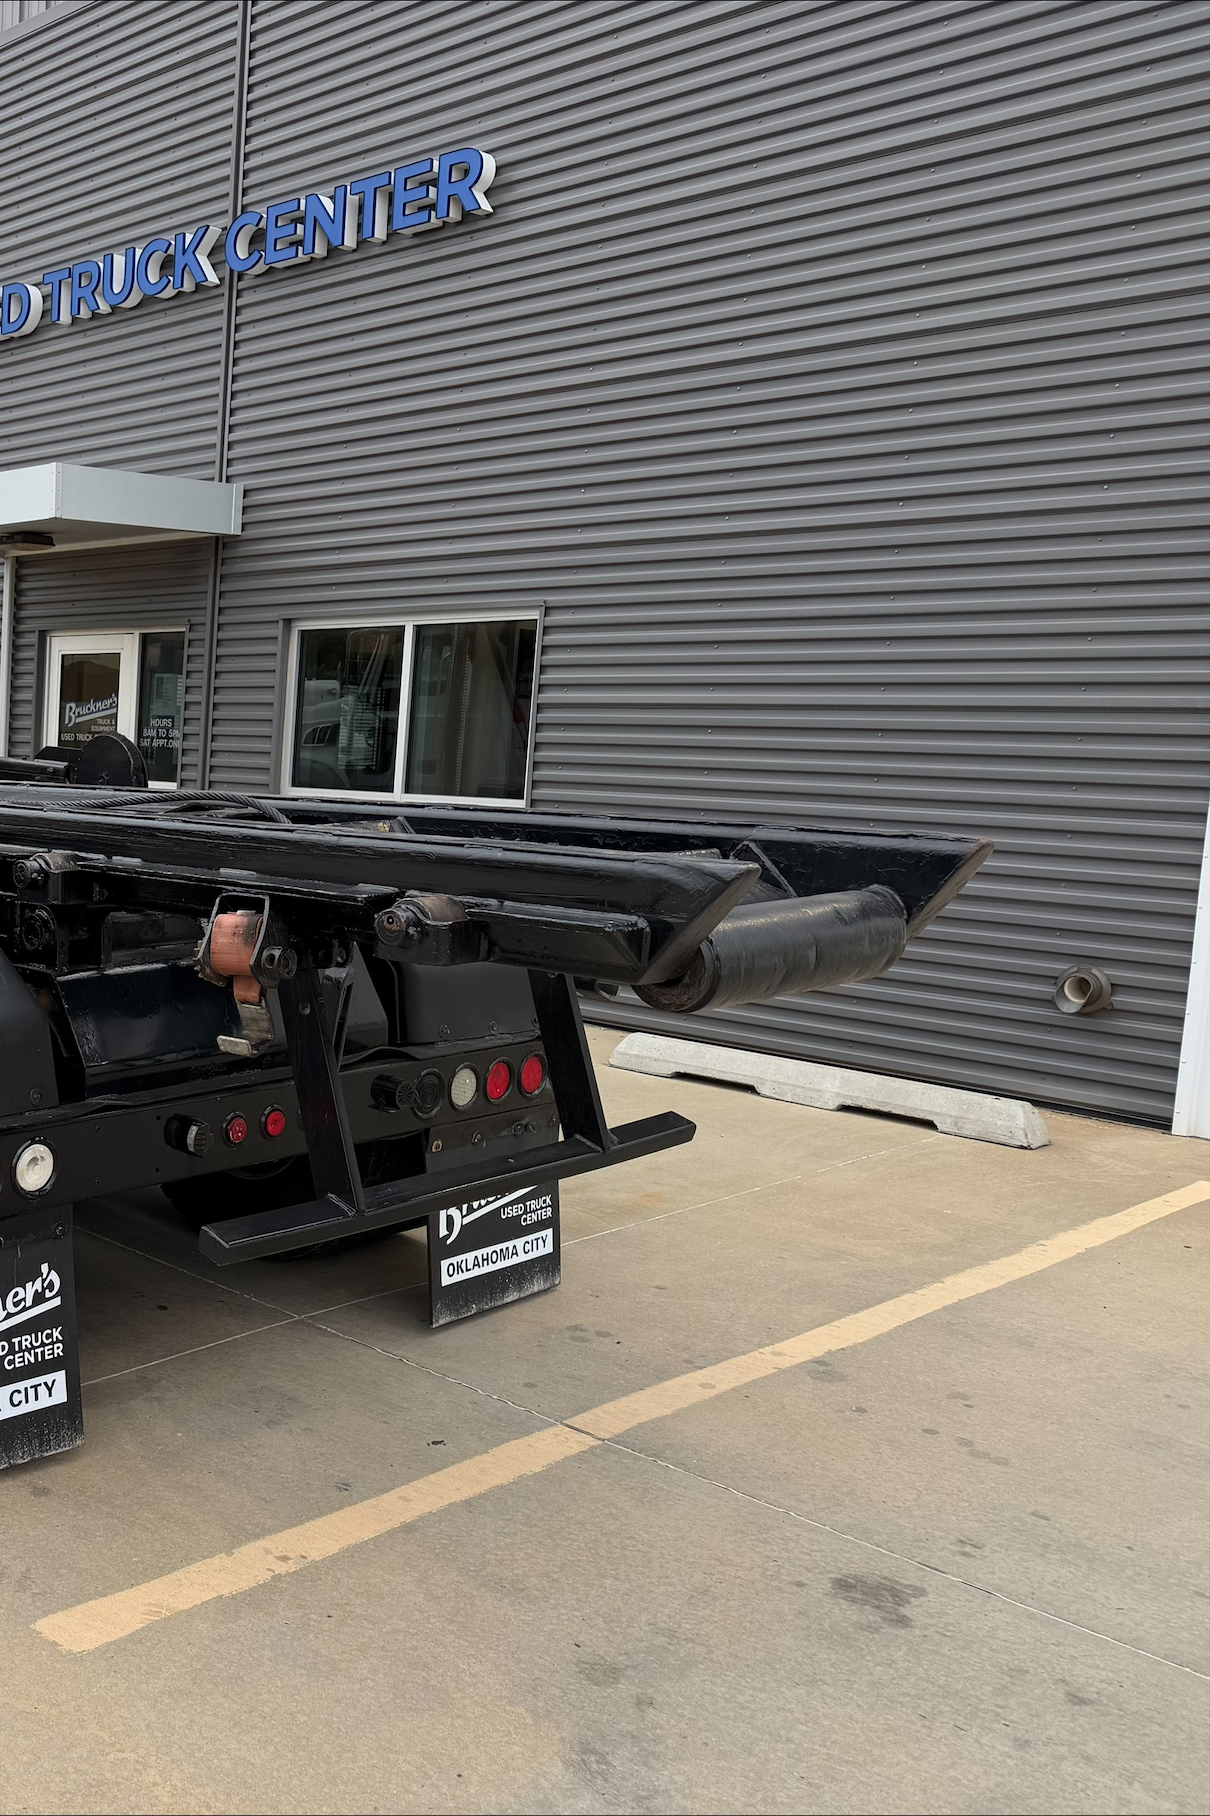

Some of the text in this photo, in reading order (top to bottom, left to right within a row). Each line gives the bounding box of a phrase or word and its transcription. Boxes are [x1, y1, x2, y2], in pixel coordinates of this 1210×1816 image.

[43, 225, 222, 325] TRUCK
[225, 147, 496, 275] CENTER
[64, 693, 117, 728] Bruckner's
[150, 718, 173, 727] HOURS
[60, 733, 75, 741] USED
[139, 738, 150, 747] SAT
[142, 728, 157, 737] 8AM
[158, 729, 167, 737] TO
[500, 1194, 552, 1219] USED TRUCK
[520, 1206, 552, 1226] CENTER
[446, 1234, 549, 1278] OKLAHOMA CITY
[11, 1326, 63, 1351] TRUCK
[3, 1343, 64, 1370] CENTER
[9, 1378, 58, 1408] CITY
